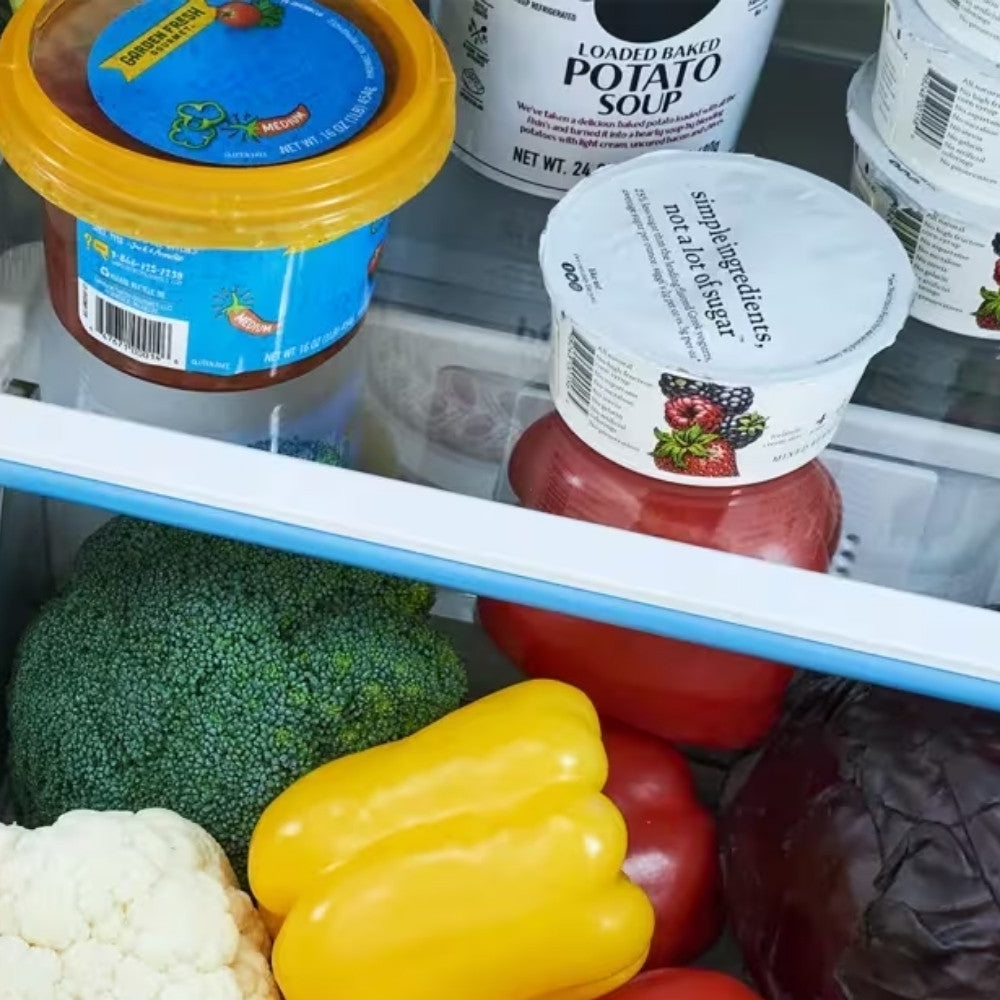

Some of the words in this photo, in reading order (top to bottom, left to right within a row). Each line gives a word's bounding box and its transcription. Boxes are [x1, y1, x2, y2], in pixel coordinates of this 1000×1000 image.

[119, 31, 167, 66] GARDEN
[162, 6, 206, 34] FRESH
[578, 42, 658, 61] LOADED
[661, 37, 721, 59] BAKED
[563, 53, 722, 92] POTATO
[597, 90, 682, 116] SOUP
[279, 141, 301, 155] NET
[513, 146, 540, 168] NET
[543, 155, 567, 175] WT.
[573, 160, 591, 177] 24
[663, 203, 692, 233] not
[676, 234, 692, 245] a
[682, 246, 706, 271] lot
[690, 190, 731, 244] simple
[716, 241, 772, 349] ingredients,
[693, 272, 722, 290] of
[702, 289, 736, 338] sugar
